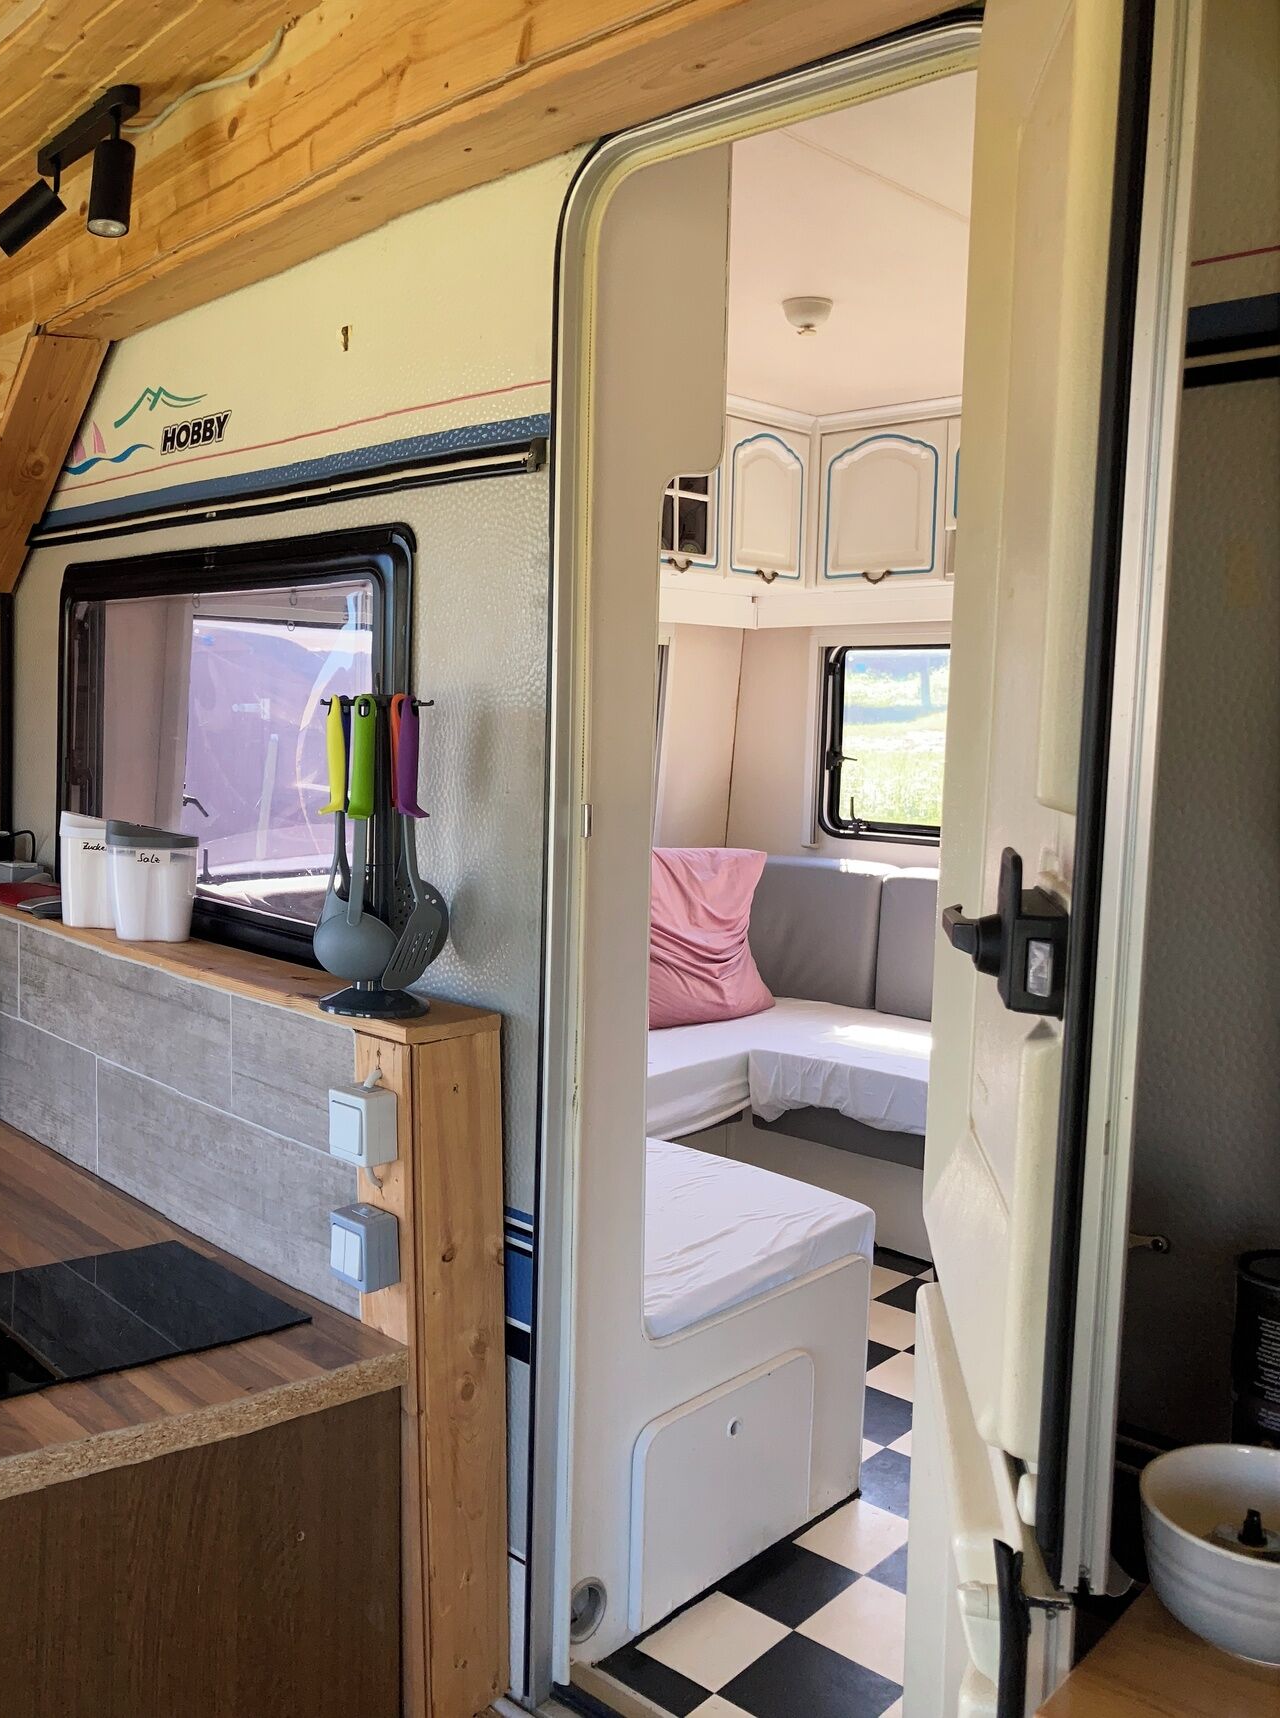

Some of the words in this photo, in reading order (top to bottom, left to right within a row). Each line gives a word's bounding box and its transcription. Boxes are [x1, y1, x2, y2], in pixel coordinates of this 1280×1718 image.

[161, 411, 231, 454] HOBBY
[82, 842, 107, 852] Zucke
[137, 853, 160, 864] Salz
